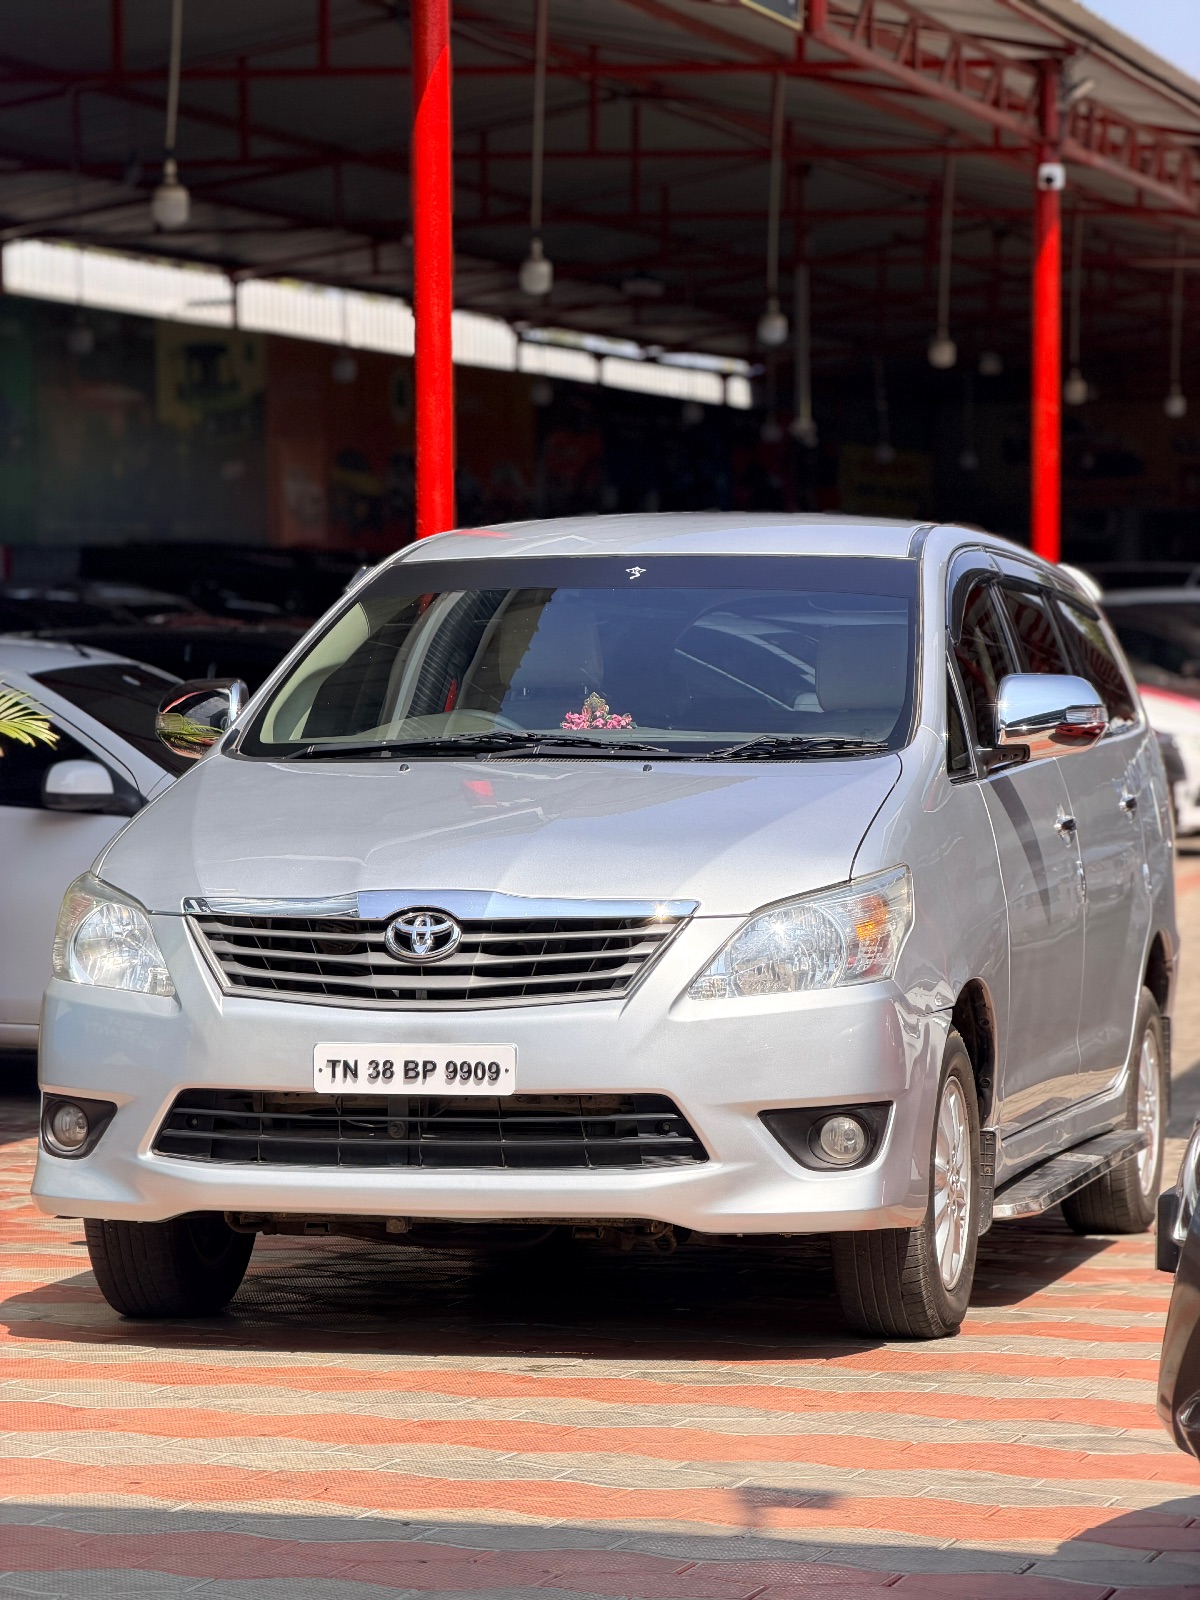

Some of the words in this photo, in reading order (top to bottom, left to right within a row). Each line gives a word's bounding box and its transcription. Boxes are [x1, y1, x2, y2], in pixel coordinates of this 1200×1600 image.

[326, 1059, 358, 1079] TN
[368, 1060, 394, 1080] 38
[403, 1060, 437, 1080] BP
[445, 1060, 501, 1081] 9909
